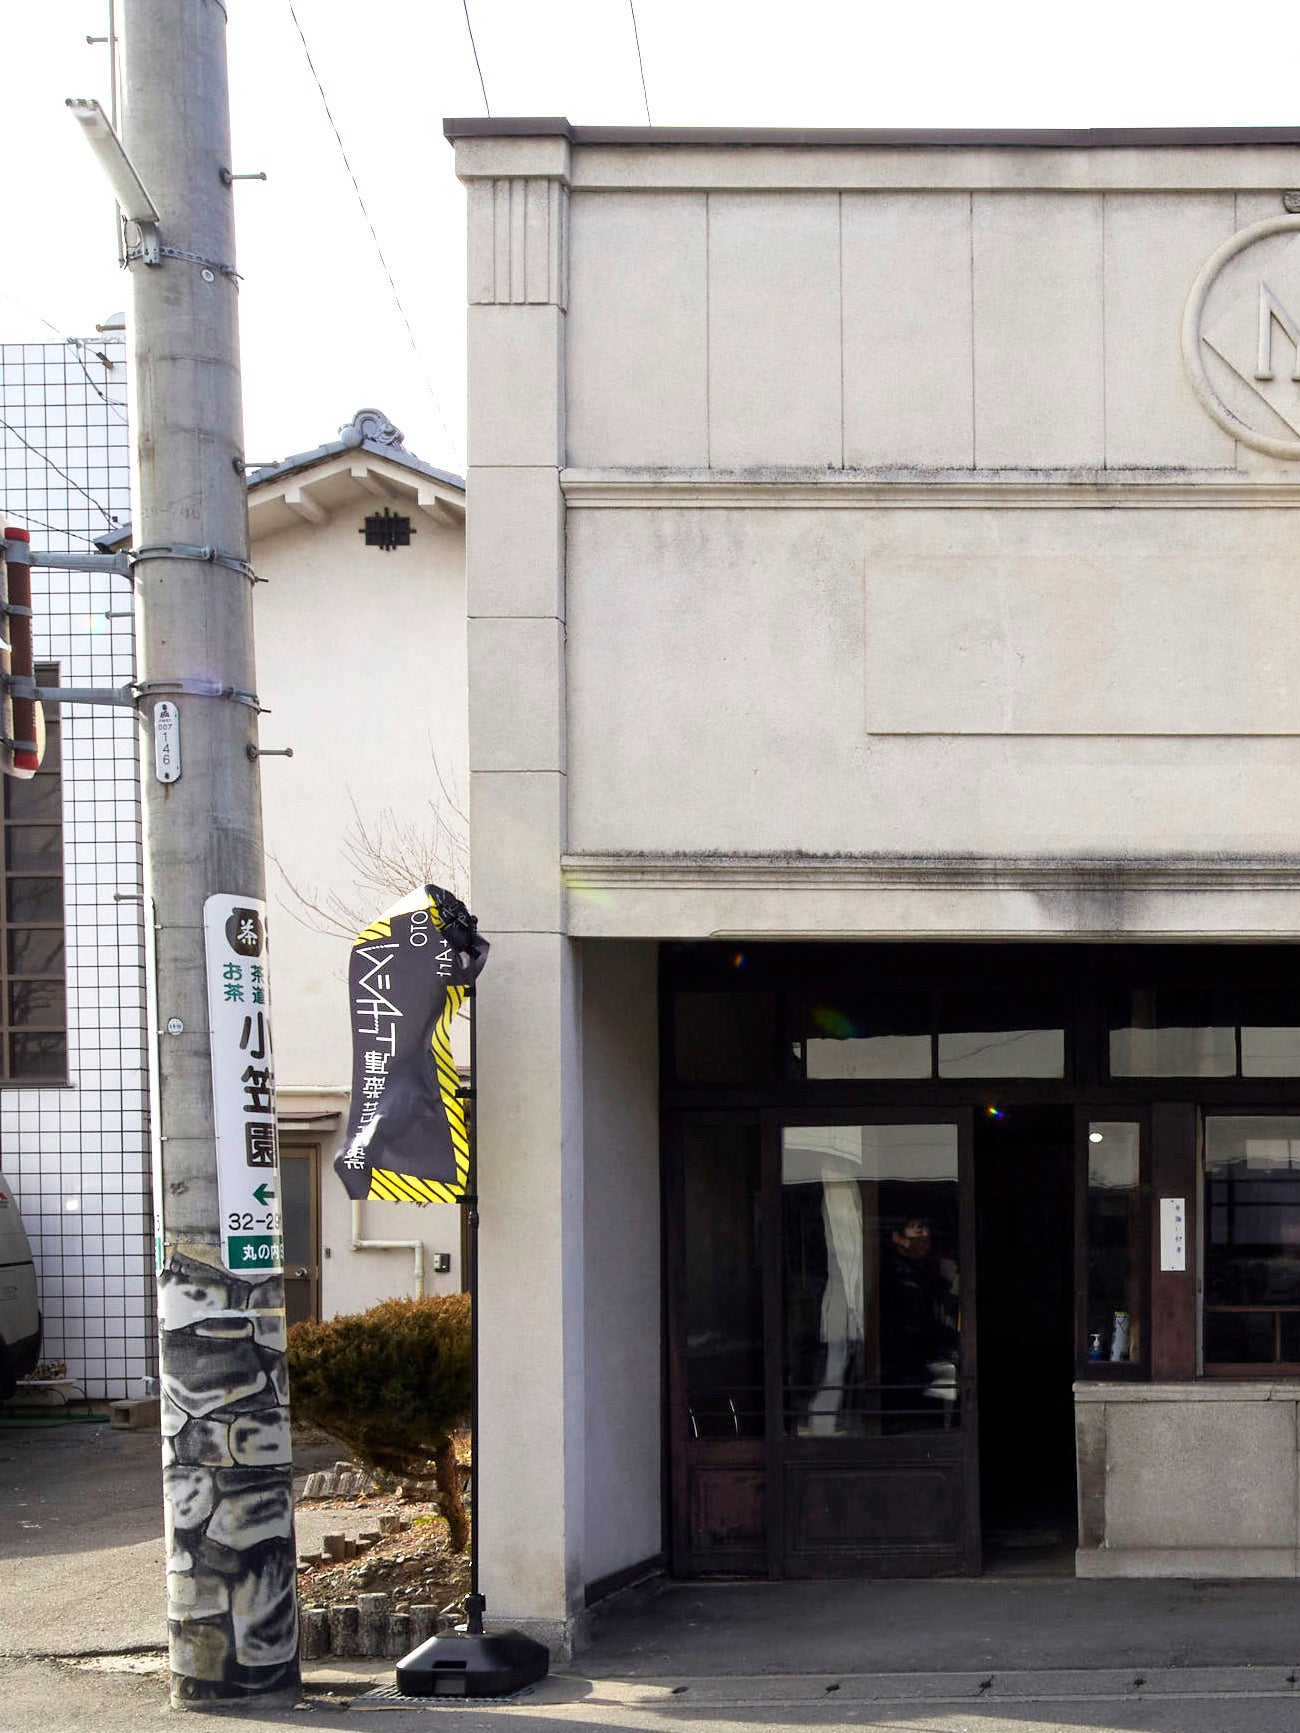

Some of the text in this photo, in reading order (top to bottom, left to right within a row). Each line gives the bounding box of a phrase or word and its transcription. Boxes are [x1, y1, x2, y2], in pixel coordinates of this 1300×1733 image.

[237, 919, 258, 946] 茶
[222, 961, 245, 1003] お茶
[239, 1011, 278, 1168] 小笠園
